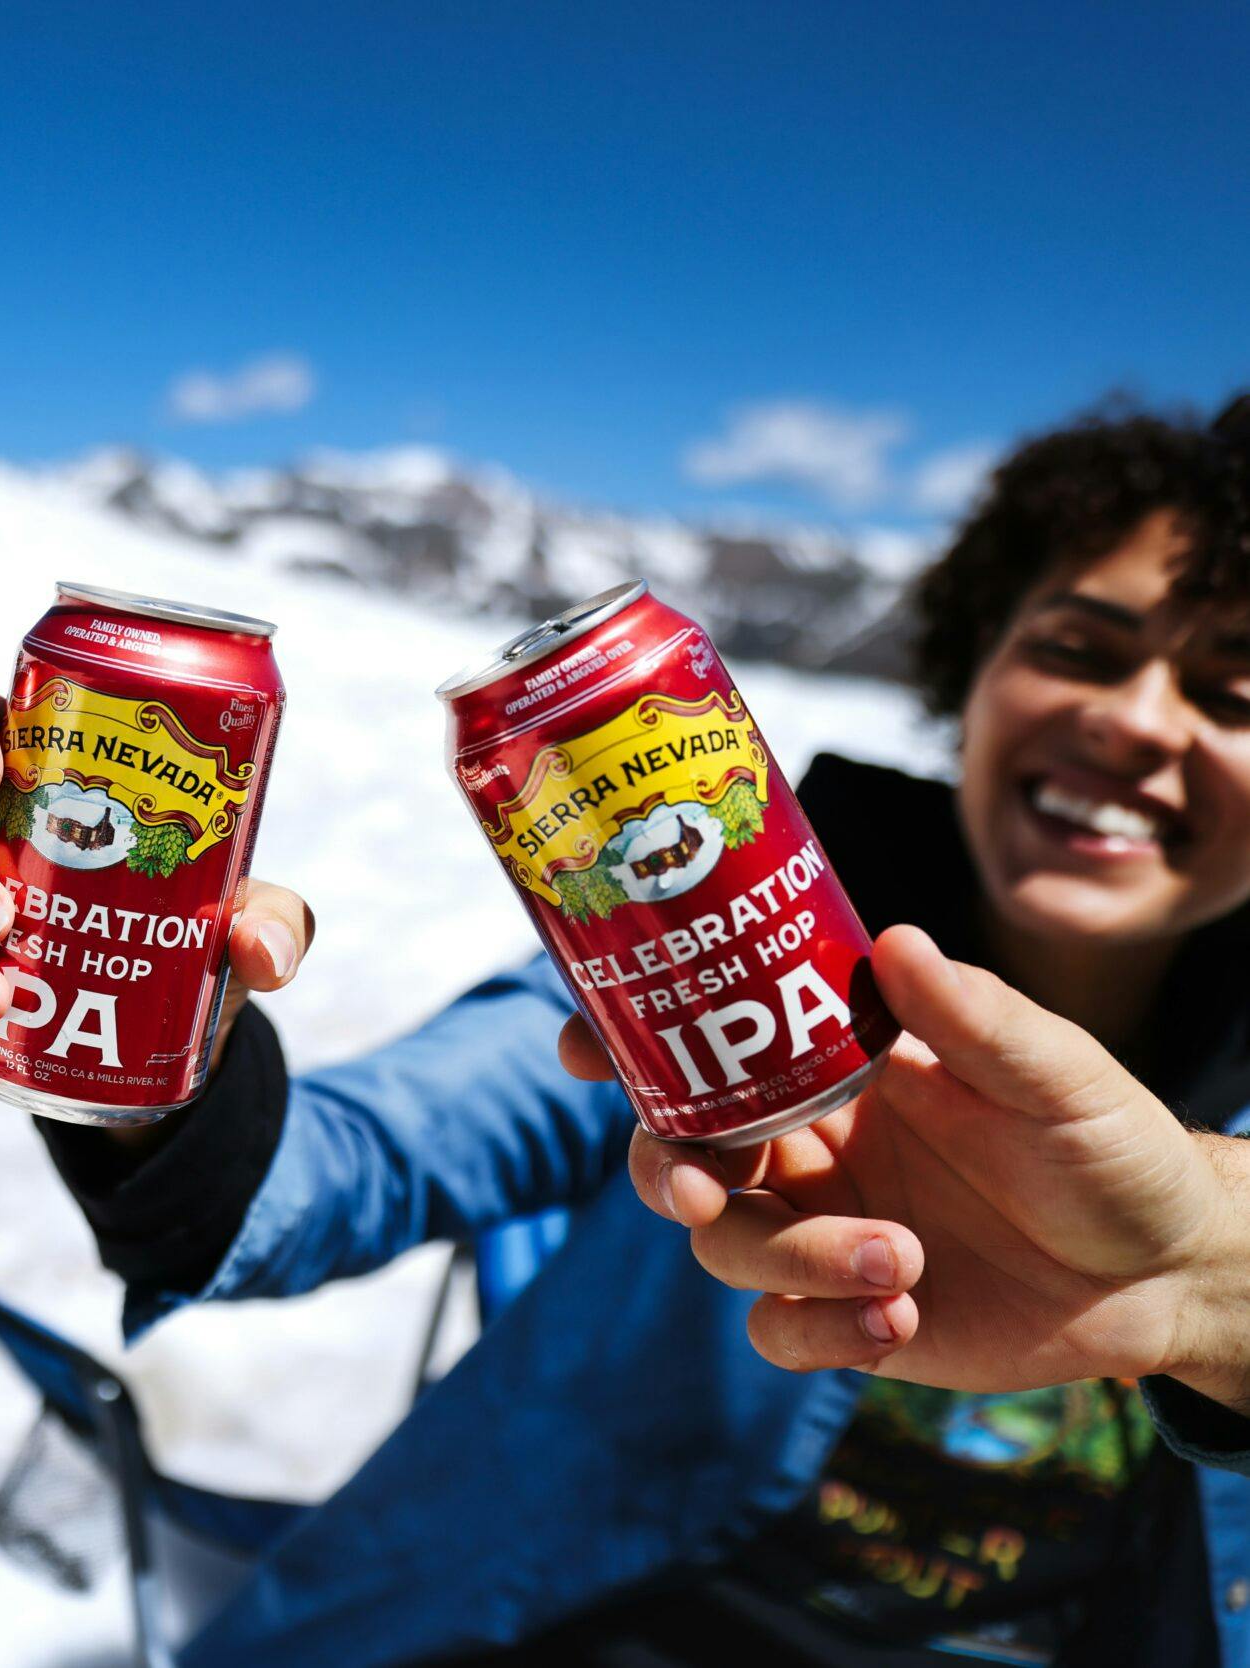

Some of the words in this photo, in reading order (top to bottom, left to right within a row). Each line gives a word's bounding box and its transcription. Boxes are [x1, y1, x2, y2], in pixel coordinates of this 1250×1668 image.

[64, 625, 108, 644] OPERATED
[108, 636, 117, 647] &
[90, 619, 124, 635] FAMILY
[505, 683, 556, 715] OPERATED
[556, 678, 566, 690] &
[566, 655, 609, 685] ARGUED
[606, 640, 635, 660] OVER
[524, 665, 561, 692] FAMILY
[230, 697, 254, 713] Finest
[219, 711, 256, 732] Quality
[4, 725, 85, 753] SIERRA
[516, 774, 619, 858] SIERRA
[620, 729, 740, 787] NEVADA
[5, 877, 209, 949] EBRATION
[570, 839, 825, 991] CELEBRATION
[6, 928, 67, 967] ESH
[80, 950, 152, 982] HOP
[628, 955, 749, 1020] FRESH
[755, 909, 816, 967] HOP
[656, 959, 853, 1098] IPA
[6, 1060, 14, 1070] 12
[16, 1064, 30, 1075] FL.
[34, 1071, 52, 1082] OZ.
[15, 1054, 32, 1067] CO.,
[35, 1060, 68, 1076] CHICO,
[70, 1068, 85, 1079] CA
[87, 1071, 95, 1080] &
[97, 1073, 125, 1084] MILLS
[156, 1077, 168, 1085] NC
[678, 1100, 719, 1114] NEVADA
[719, 1082, 768, 1107] BREWING
[826, 1044, 841, 1057] CA
[764, 1090, 777, 1102] 12
